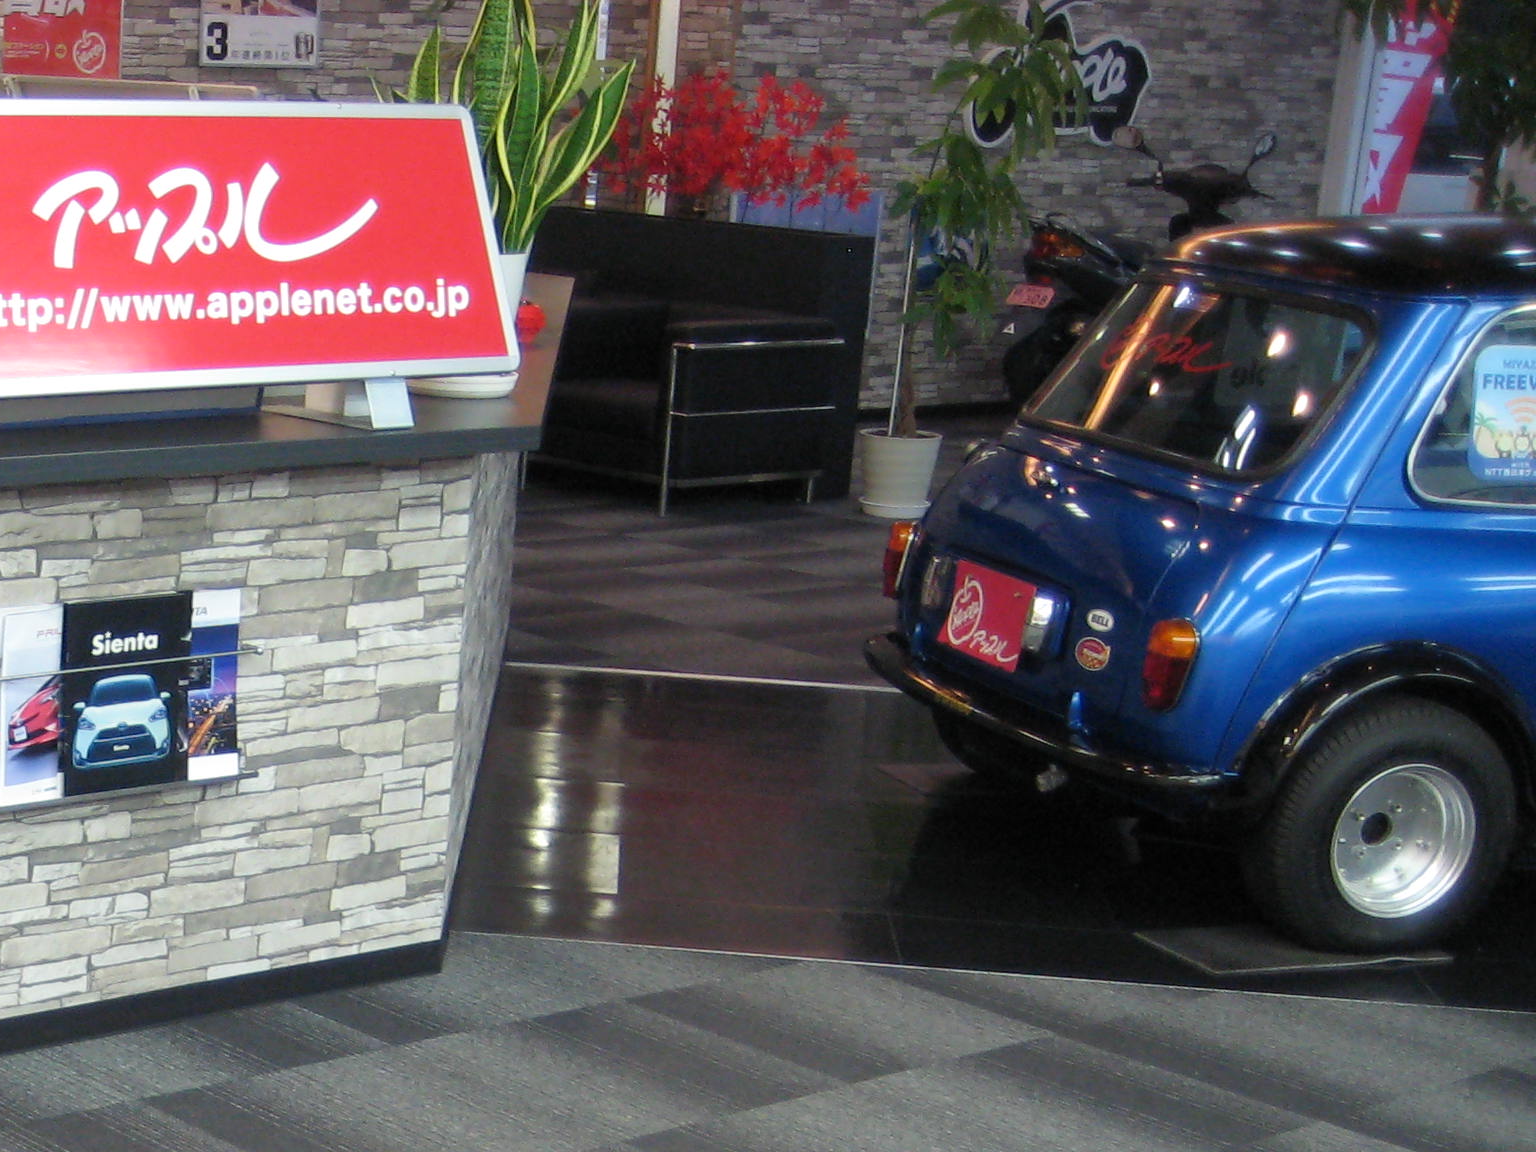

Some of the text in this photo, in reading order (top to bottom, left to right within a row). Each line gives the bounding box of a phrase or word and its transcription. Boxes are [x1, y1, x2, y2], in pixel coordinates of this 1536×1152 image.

[31, 162, 379, 270] アップル
[91, 631, 159, 656] Sienta
